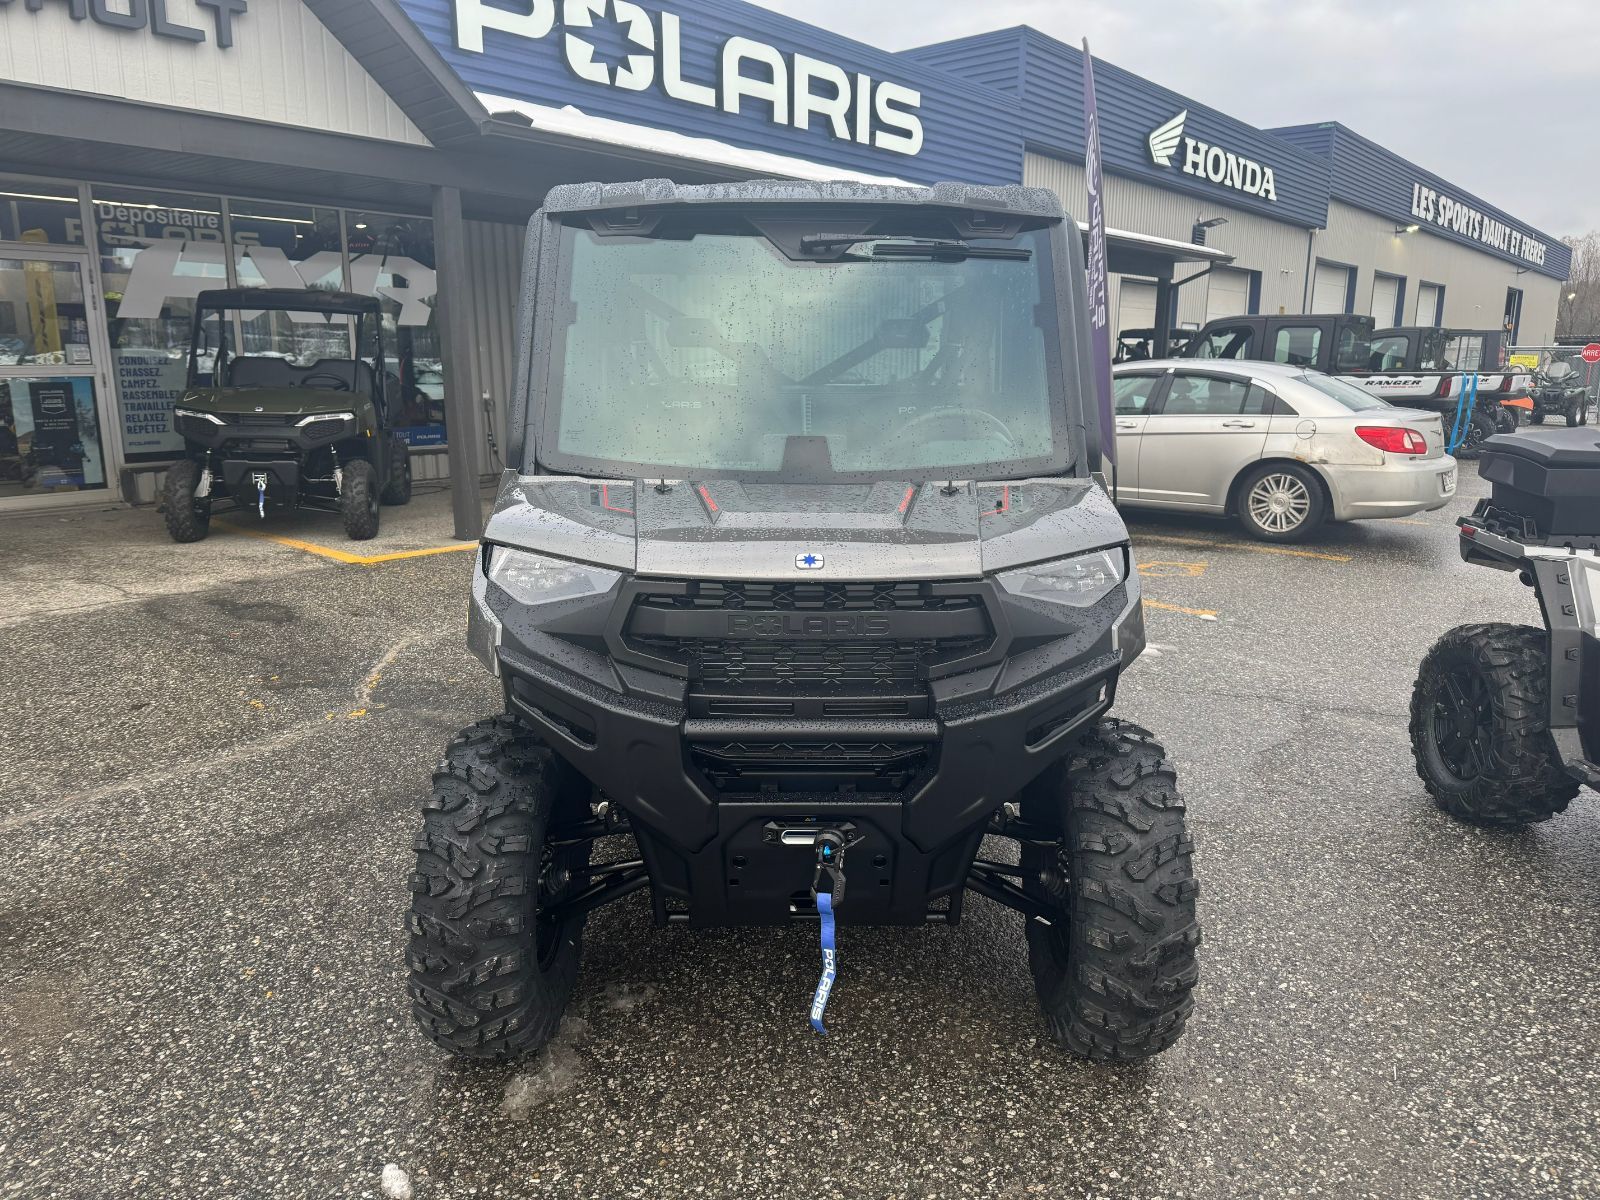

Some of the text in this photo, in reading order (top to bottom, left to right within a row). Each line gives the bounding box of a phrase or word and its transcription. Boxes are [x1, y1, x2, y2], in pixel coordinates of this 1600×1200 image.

[0, 0, 247, 48] ULT
[456, 0, 924, 156] POLARIS
[1183, 137, 1277, 201] HONDA
[1412, 182, 1436, 221] LES
[1438, 195, 1481, 239] SPORTS
[1481, 216, 1511, 251] DAULT
[1510, 230, 1521, 256] ET
[120, 367, 163, 378] CHASSEZ.
[121, 379, 160, 389] CAMPEZ.
[124, 401, 175, 412] TRAVAILLE
[126, 412, 169, 423] RELAXEZ.
[728, 615, 890, 636] POLARIS
[811, 948, 834, 1021] POLARIS
